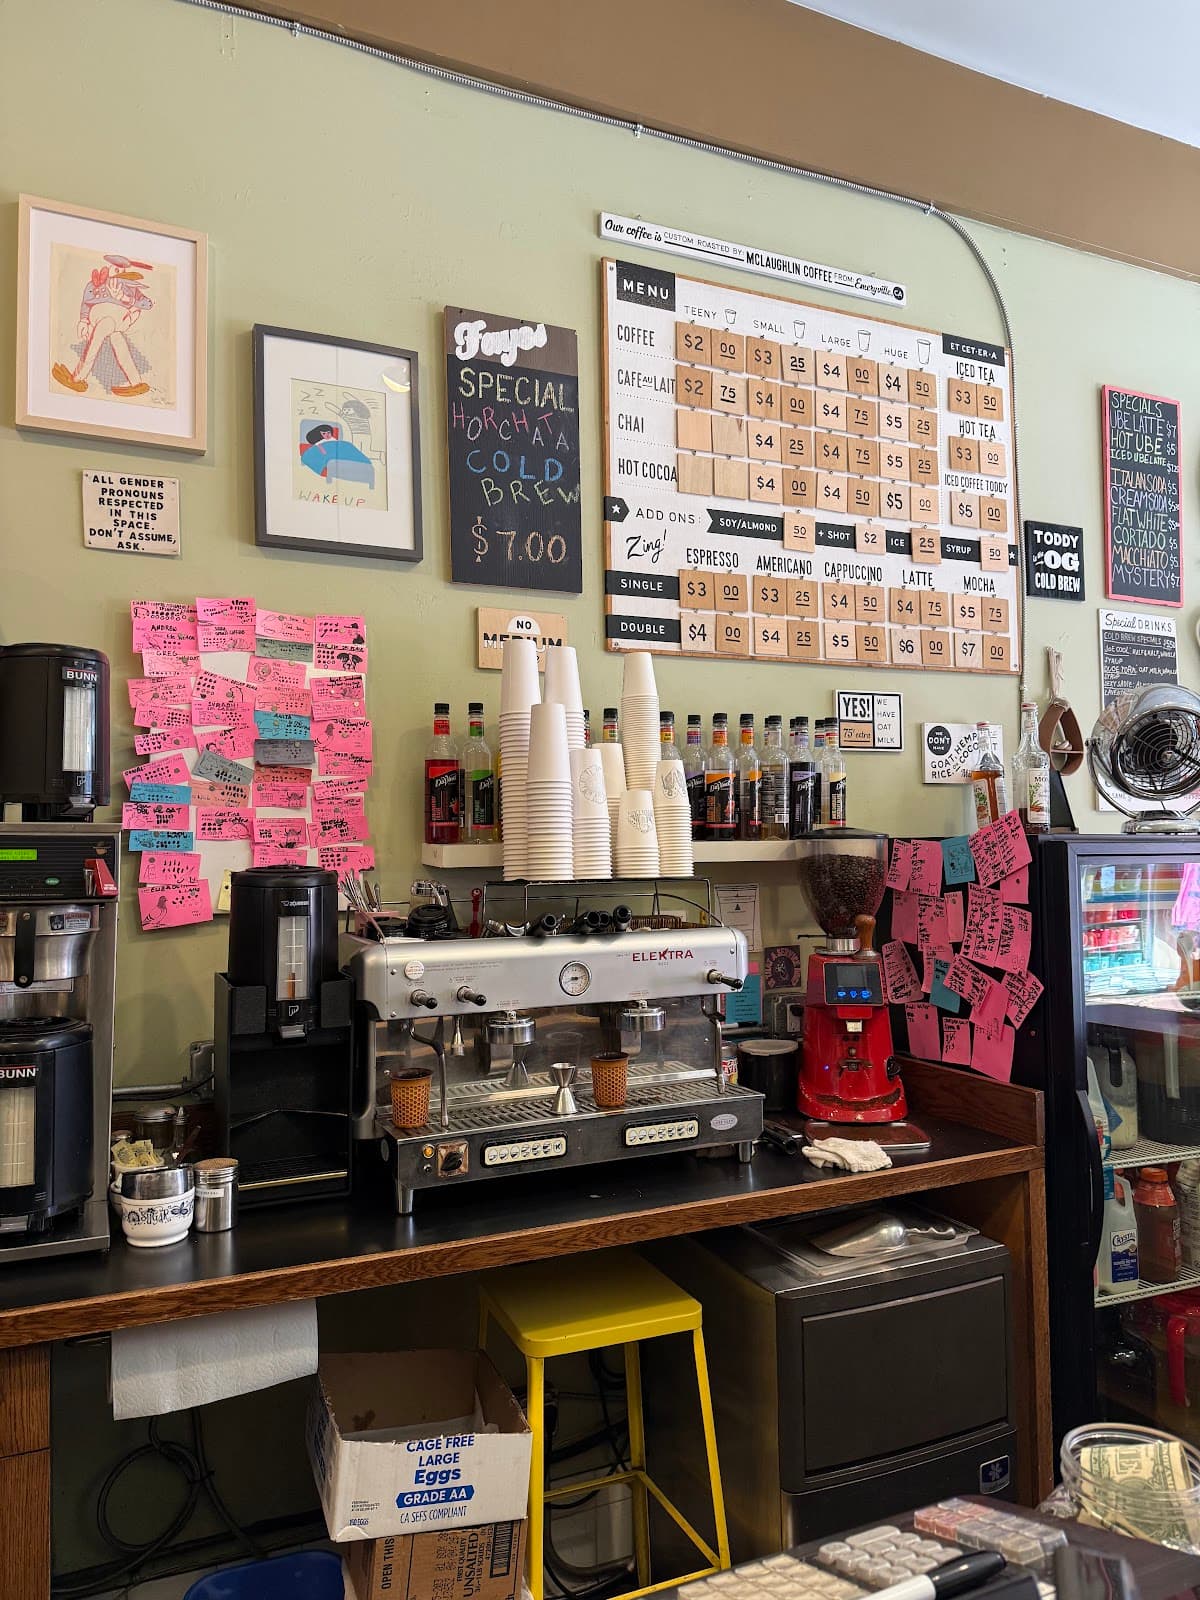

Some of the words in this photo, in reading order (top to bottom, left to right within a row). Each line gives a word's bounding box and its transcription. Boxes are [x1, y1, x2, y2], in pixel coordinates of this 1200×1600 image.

[605, 219, 624, 233] Our
[626, 226, 652, 240] coffee
[654, 232, 662, 242] is
[664, 232, 694, 245] CUSTOM
[697, 239, 729, 253] ROASTED
[746, 251, 801, 275] MCLAUGHLIN
[803, 266, 832, 283] COFFEE
[834, 273, 854, 283] FROM:
[623, 279, 669, 300] MENU
[684, 306, 717, 320] TEENY
[617, 325, 655, 346] COFFEE
[753, 320, 784, 334] SMALL
[684, 333, 704, 351] $2
[720, 343, 736, 356] 00
[821, 334, 851, 348] LARGE
[950, 343, 960, 351] ET
[754, 349, 772, 365] $3
[790, 356, 805, 369] 25
[885, 348, 908, 360] HUGE
[824, 363, 840, 377] $4
[855, 368, 869, 380] 00
[957, 361, 975, 378] ICED
[979, 367, 995, 382] TEA
[459, 366, 574, 412] SPECIAL
[617, 369, 642, 388] CAFE
[654, 376, 675, 395] LAIT
[886, 374, 901, 392] $4
[916, 381, 929, 393] 50
[956, 390, 971, 405] $3
[983, 396, 997, 407] 50
[1112, 392, 1162, 418] SPECIALS
[452, 402, 569, 450] HORCHATA
[618, 413, 644, 433] CHAI
[960, 420, 976, 436] HOT
[979, 423, 996, 439] TEA
[1110, 410, 1130, 430] UBE
[1133, 415, 1165, 436] LATTE
[1166, 421, 1176, 438] $7
[1112, 429, 1133, 449] HOT
[1136, 433, 1163, 455] UBE
[1167, 442, 1176, 455] $5
[957, 447, 972, 461] $3
[987, 453, 998, 462] 00
[1110, 449, 1132, 460] ICED
[1134, 453, 1149, 463] UBE
[1150, 456, 1166, 466] LATTE
[466, 449, 564, 482] COLD
[618, 458, 639, 477] HOT
[642, 462, 677, 482] COCOA
[93, 475, 114, 484] ALL
[120, 478, 164, 488] GENDER
[944, 474, 959, 486] ICED
[960, 476, 983, 489] COFFEE
[985, 480, 1008, 493] TODDY
[1146, 474, 1167, 494] SODA
[101, 488, 164, 499] PRONOUNS
[299, 490, 338, 504] WAKE
[345, 497, 365, 507] UP
[481, 477, 582, 506] BREW
[1111, 486, 1148, 508] CREAM
[1148, 493, 1168, 513] SODA
[99, 498, 163, 510] RESPECTED
[959, 503, 972, 518] $5
[987, 507, 1000, 518] 00
[110, 509, 121, 517] IN
[130, 511, 157, 520] THIS
[636, 508, 664, 520] ADD
[1112, 505, 1135, 526] FLAT
[114, 520, 154, 530] SPACE.
[720, 518, 776, 532] SOY/ALMOND
[793, 526, 806, 535] 50
[89, 528, 123, 537] DON'T
[130, 532, 176, 544] ASSUME,
[828, 530, 850, 541] SHOT
[864, 532, 877, 544] $2
[891, 538, 905, 546] ICE
[920, 538, 934, 548] 25
[1034, 530, 1079, 548] TODDY
[1114, 526, 1166, 549] CORTADO
[118, 542, 144, 550] ASK.
[626, 528, 666, 564] Zing!
[946, 544, 971, 554] SYRUP
[990, 549, 1000, 557] 50
[686, 548, 739, 568] ESPRESSO
[756, 555, 812, 575] AMERICANO
[1044, 550, 1079, 572] OG
[824, 561, 882, 582] CAPPUCCINO
[903, 570, 933, 587] LATTE
[1112, 564, 1170, 589] MYSTERY
[621, 579, 663, 591] SINGLE
[964, 575, 995, 593] MOCHA
[1035, 572, 1056, 589] COLD
[1058, 575, 1080, 592] BREW
[517, 621, 531, 629] NO
[620, 622, 665, 634] DOUBLE
[1105, 613, 1136, 629] Special
[1138, 620, 1172, 632] DRINKS
[484, 633, 562, 652] MEUM
[66, 670, 97, 682] BUNN
[843, 697, 869, 717] YES!
[928, 736, 950, 744] DON'T
[632, 948, 693, 961] ELEKTRA
[407, 1438, 442, 1452] CAGE
[446, 1435, 475, 1448] FREE
[419, 1452, 460, 1467] LARGE
[414, 1468, 461, 1486] Eggs
[404, 1490, 445, 1505] GRADE
[450, 1488, 467, 1499] AA
[400, 1512, 410, 1524] CA
[412, 1510, 427, 1522] SEFS
[428, 1506, 467, 1521] COMPLIANT
[384, 1536, 394, 1561] THIS
[464, 1533, 478, 1597] UNSALTED
[382, 1564, 392, 1589] OPEN
